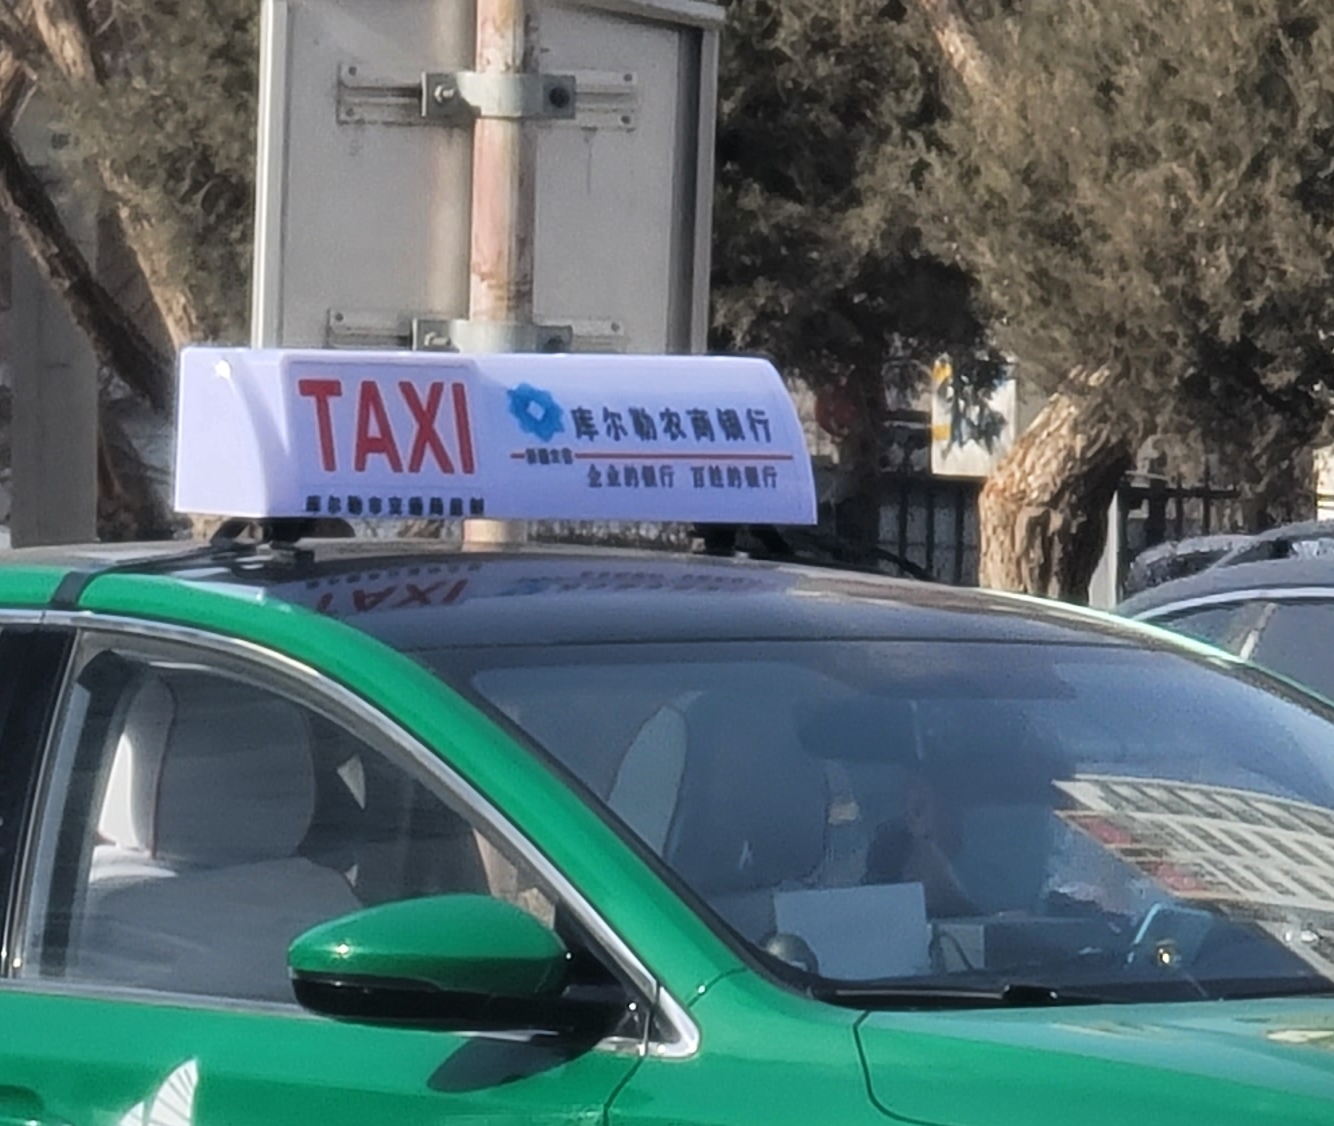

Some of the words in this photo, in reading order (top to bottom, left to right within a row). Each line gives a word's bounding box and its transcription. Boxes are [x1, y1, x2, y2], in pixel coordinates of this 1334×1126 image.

[298, 378, 476, 475] TAXI
[571, 406, 772, 443] 库尔勒农商银行
[587, 463, 675, 488] 企业的银行
